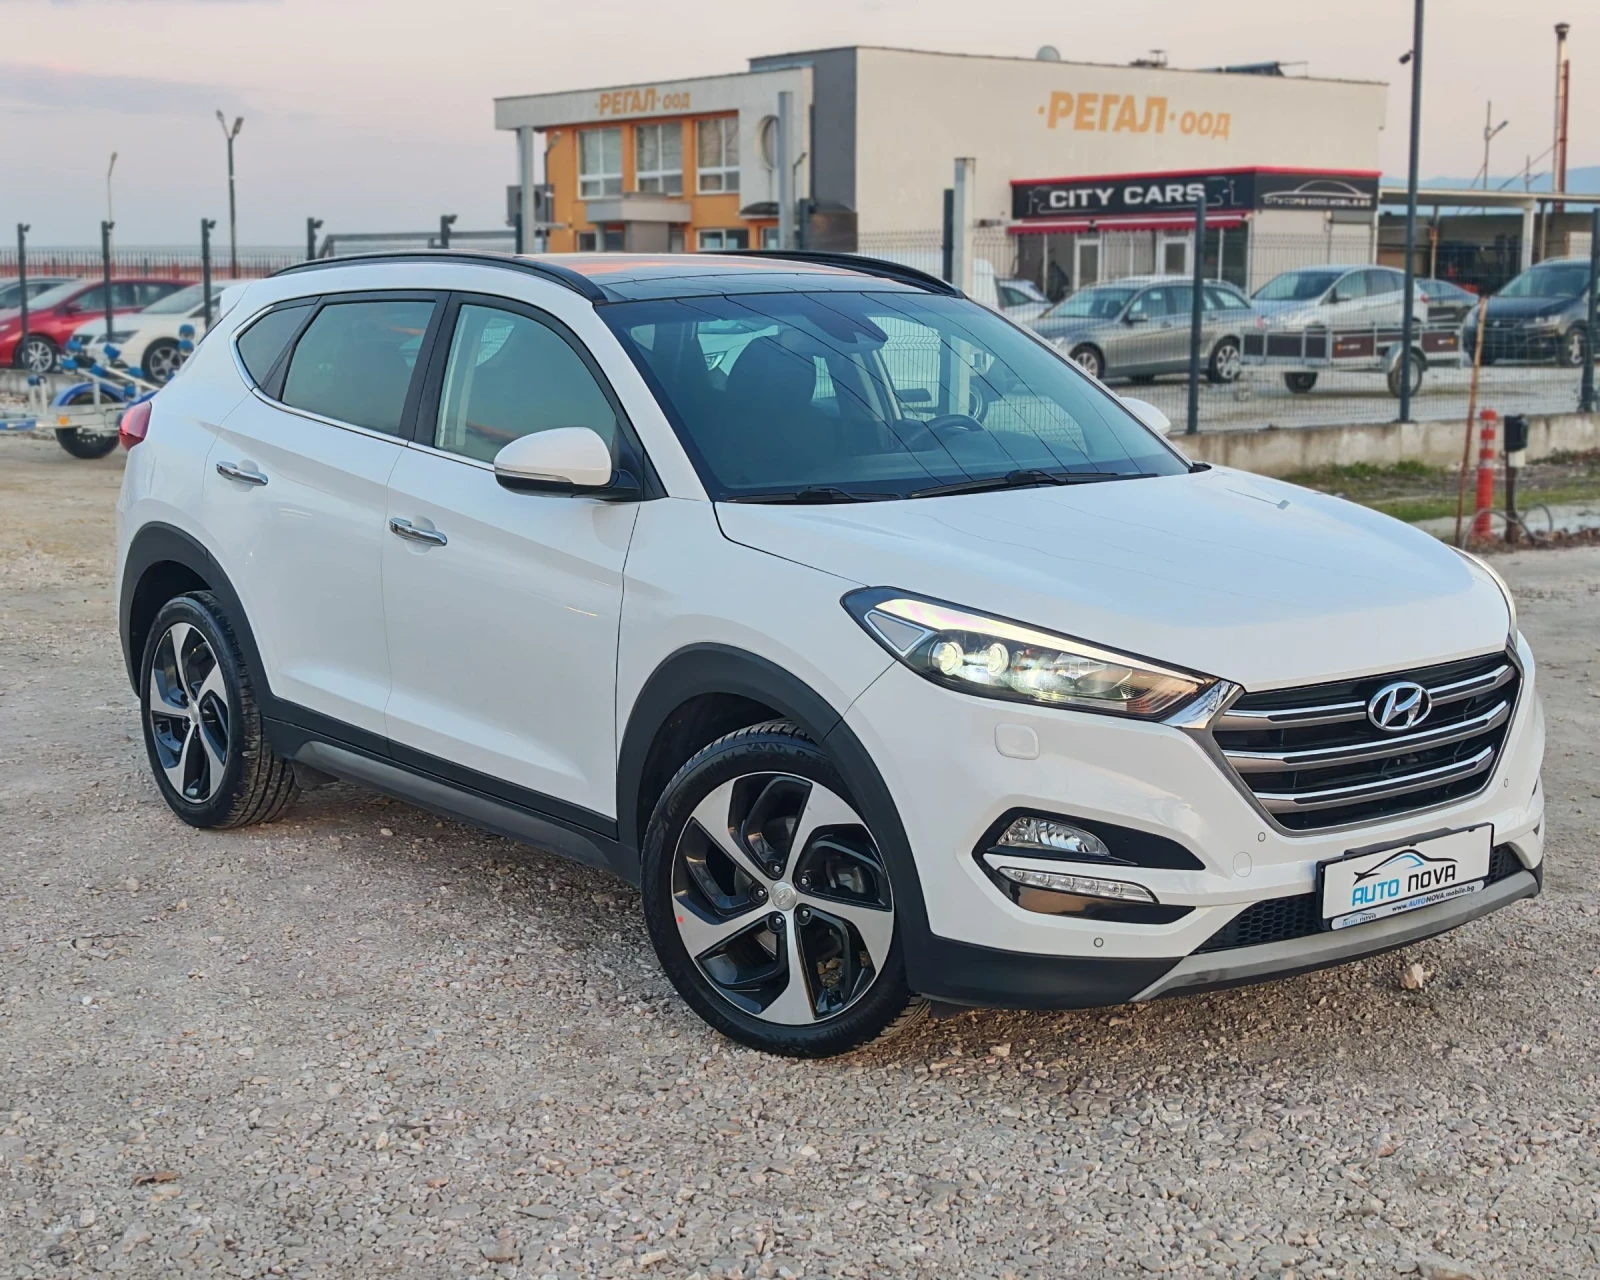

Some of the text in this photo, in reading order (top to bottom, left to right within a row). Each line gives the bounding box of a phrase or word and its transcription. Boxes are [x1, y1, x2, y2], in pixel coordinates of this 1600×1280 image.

[1047, 91, 1168, 133] РЕГАЛ
[1050, 184, 1206, 208] CITY CARS
[1352, 864, 1456, 906] AUTO NOVA
[1391, 885, 1475, 912] www.AUTONOVA.mobile.bg
